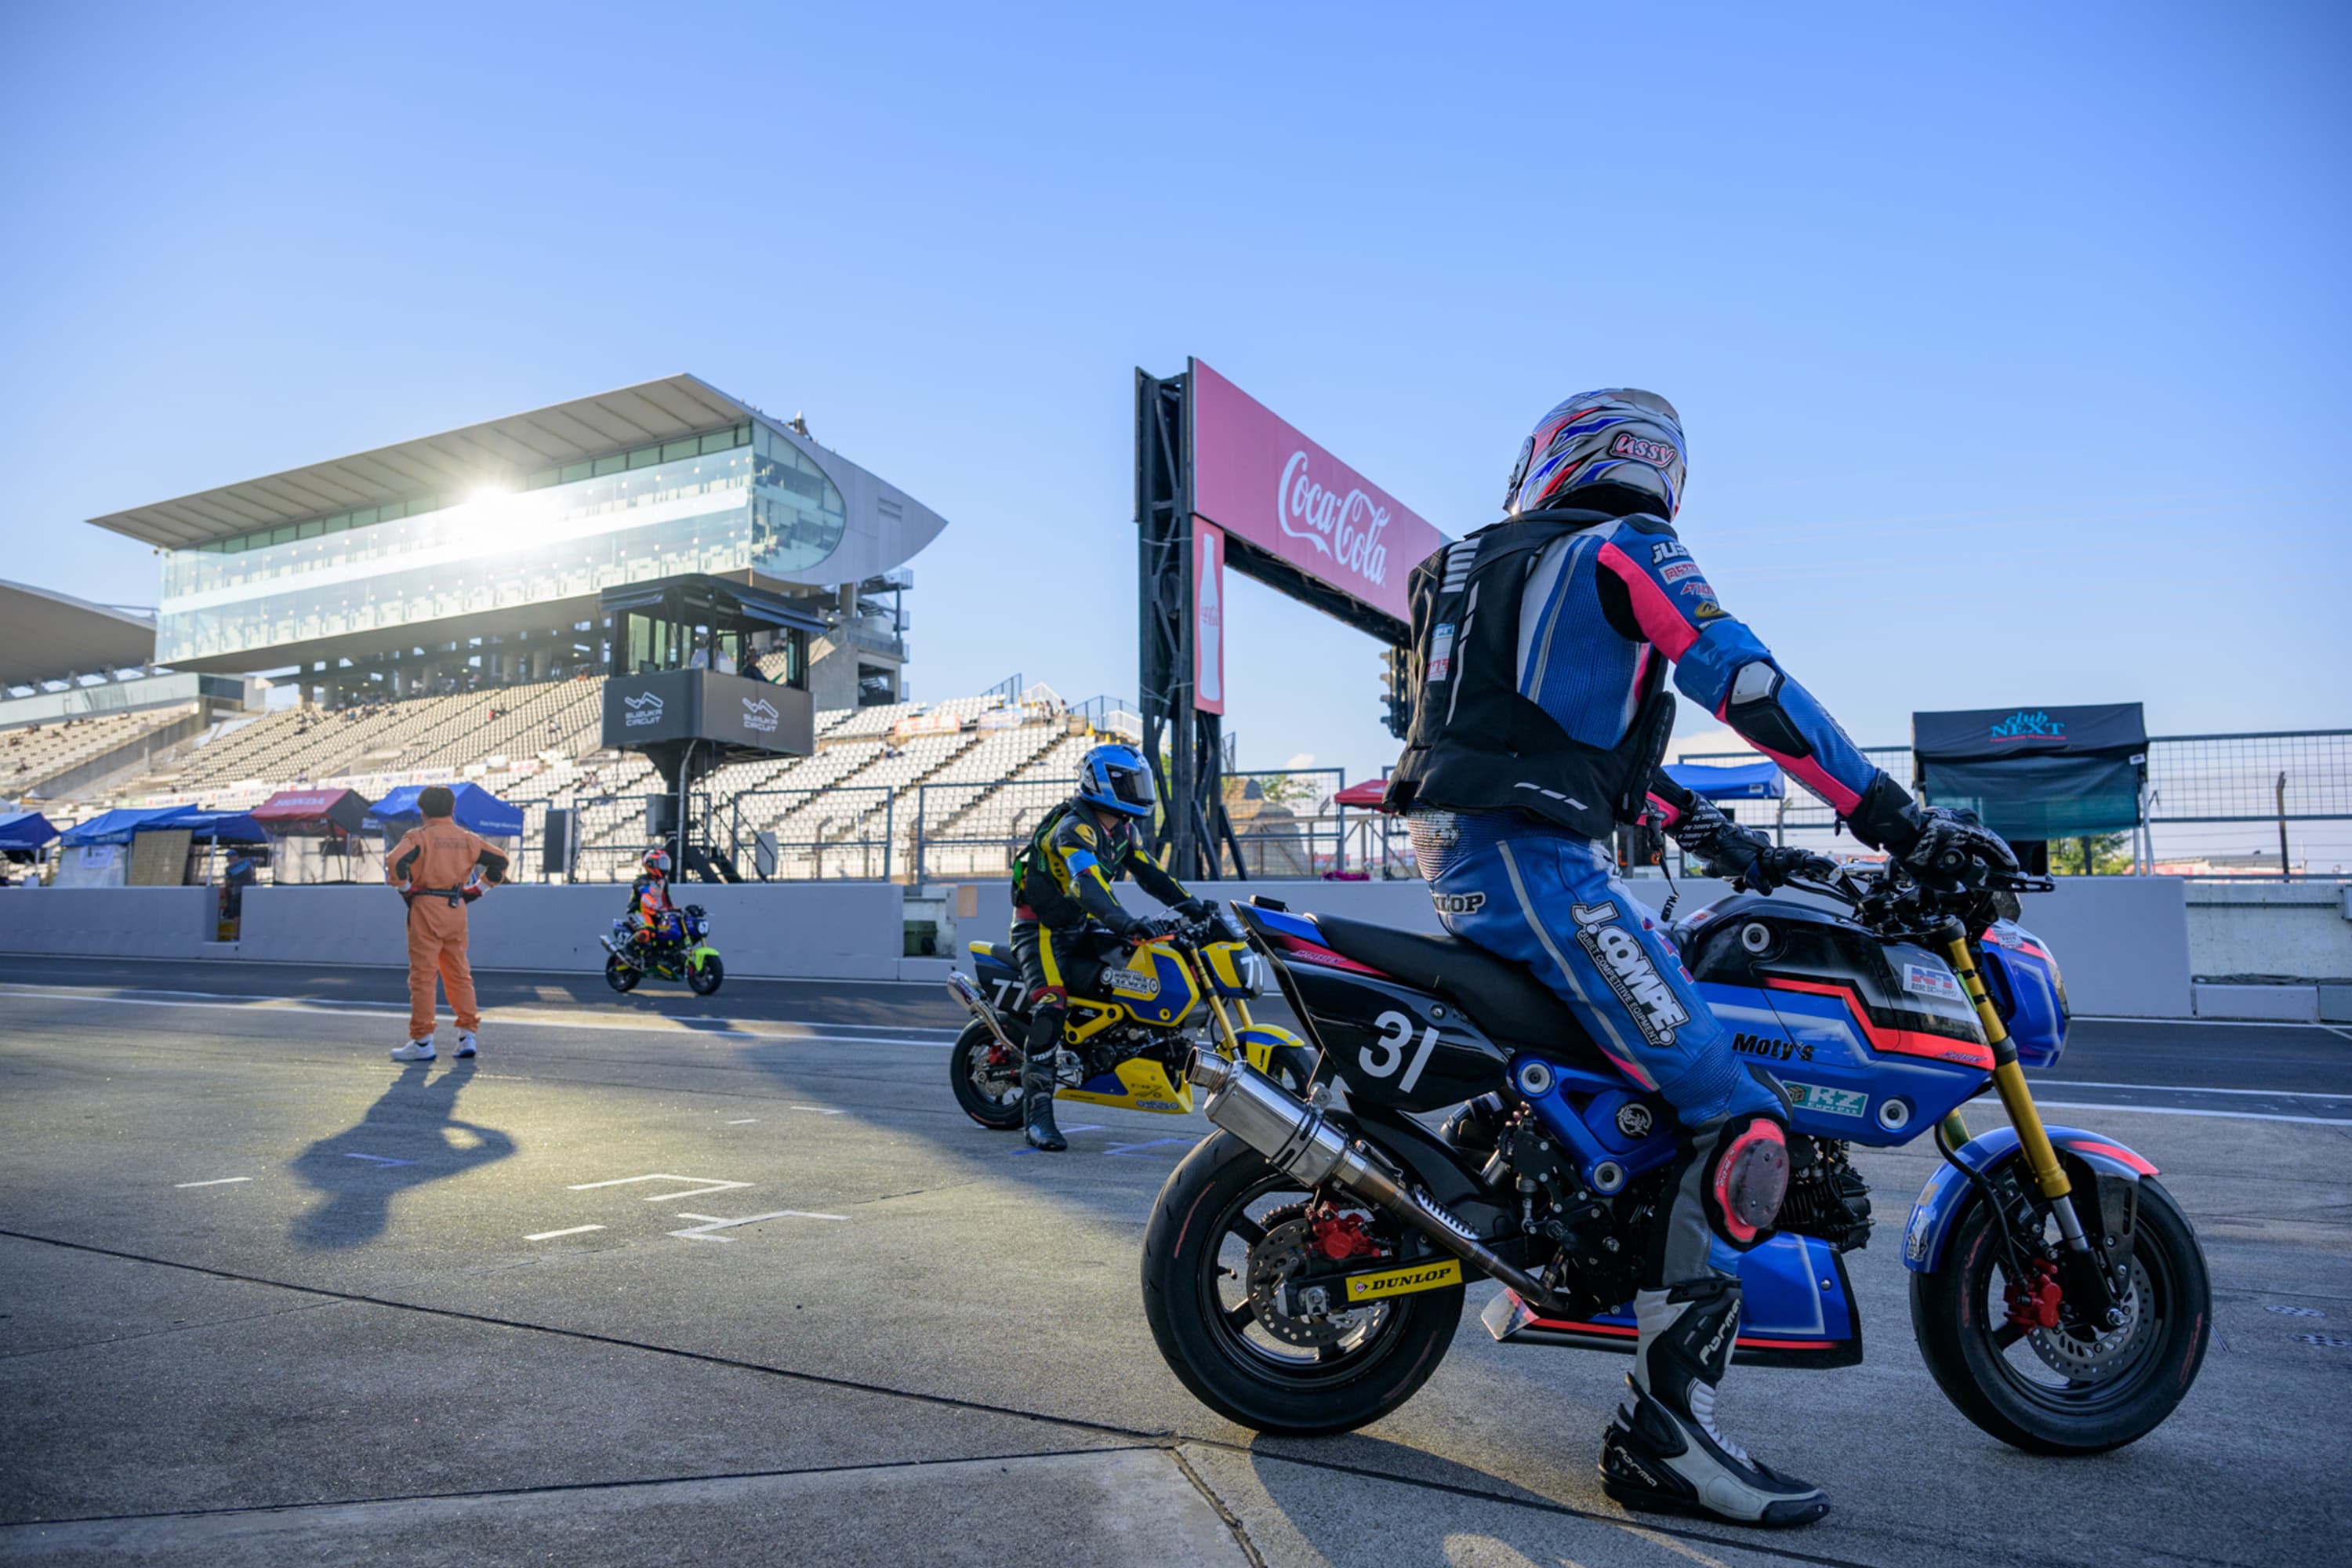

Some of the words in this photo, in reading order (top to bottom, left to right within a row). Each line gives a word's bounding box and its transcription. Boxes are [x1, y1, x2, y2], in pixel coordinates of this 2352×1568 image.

[1278, 451, 1391, 586] Coca-Cola
[626, 716, 662, 727] CIRCUIT
[743, 720, 777, 733] CIRCUIT
[1991, 721, 2066, 738] NEXT
[2005, 710, 2049, 725] club
[1595, 953, 1634, 1004] COMPETITIVE
[992, 978, 1026, 1012] 77
[1358, 1010, 1440, 1094] 31
[1731, 1033, 1816, 1061] Moty's
[1370, 1268, 1452, 1291] DUNLOP
